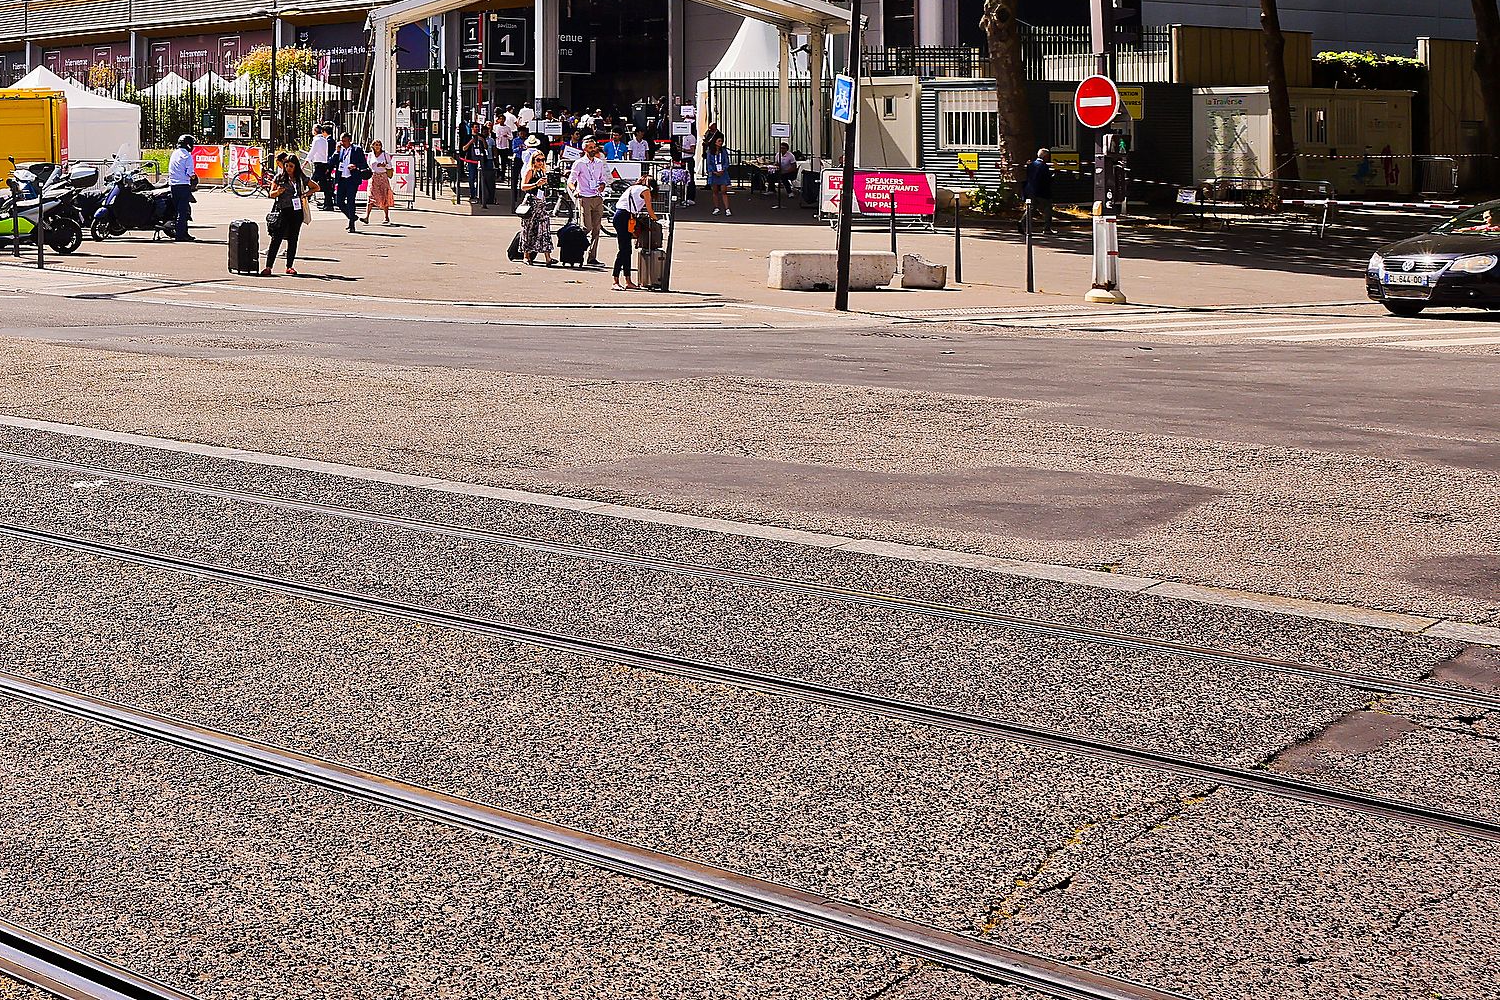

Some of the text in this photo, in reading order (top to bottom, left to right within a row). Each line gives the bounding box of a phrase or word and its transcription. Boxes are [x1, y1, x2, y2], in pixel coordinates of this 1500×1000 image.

[500, 34, 515, 56] 1
[865, 177, 904, 185] SPEAKERS
[864, 184, 919, 192] INTERVENANTS
[864, 192, 890, 200] MEDIA
